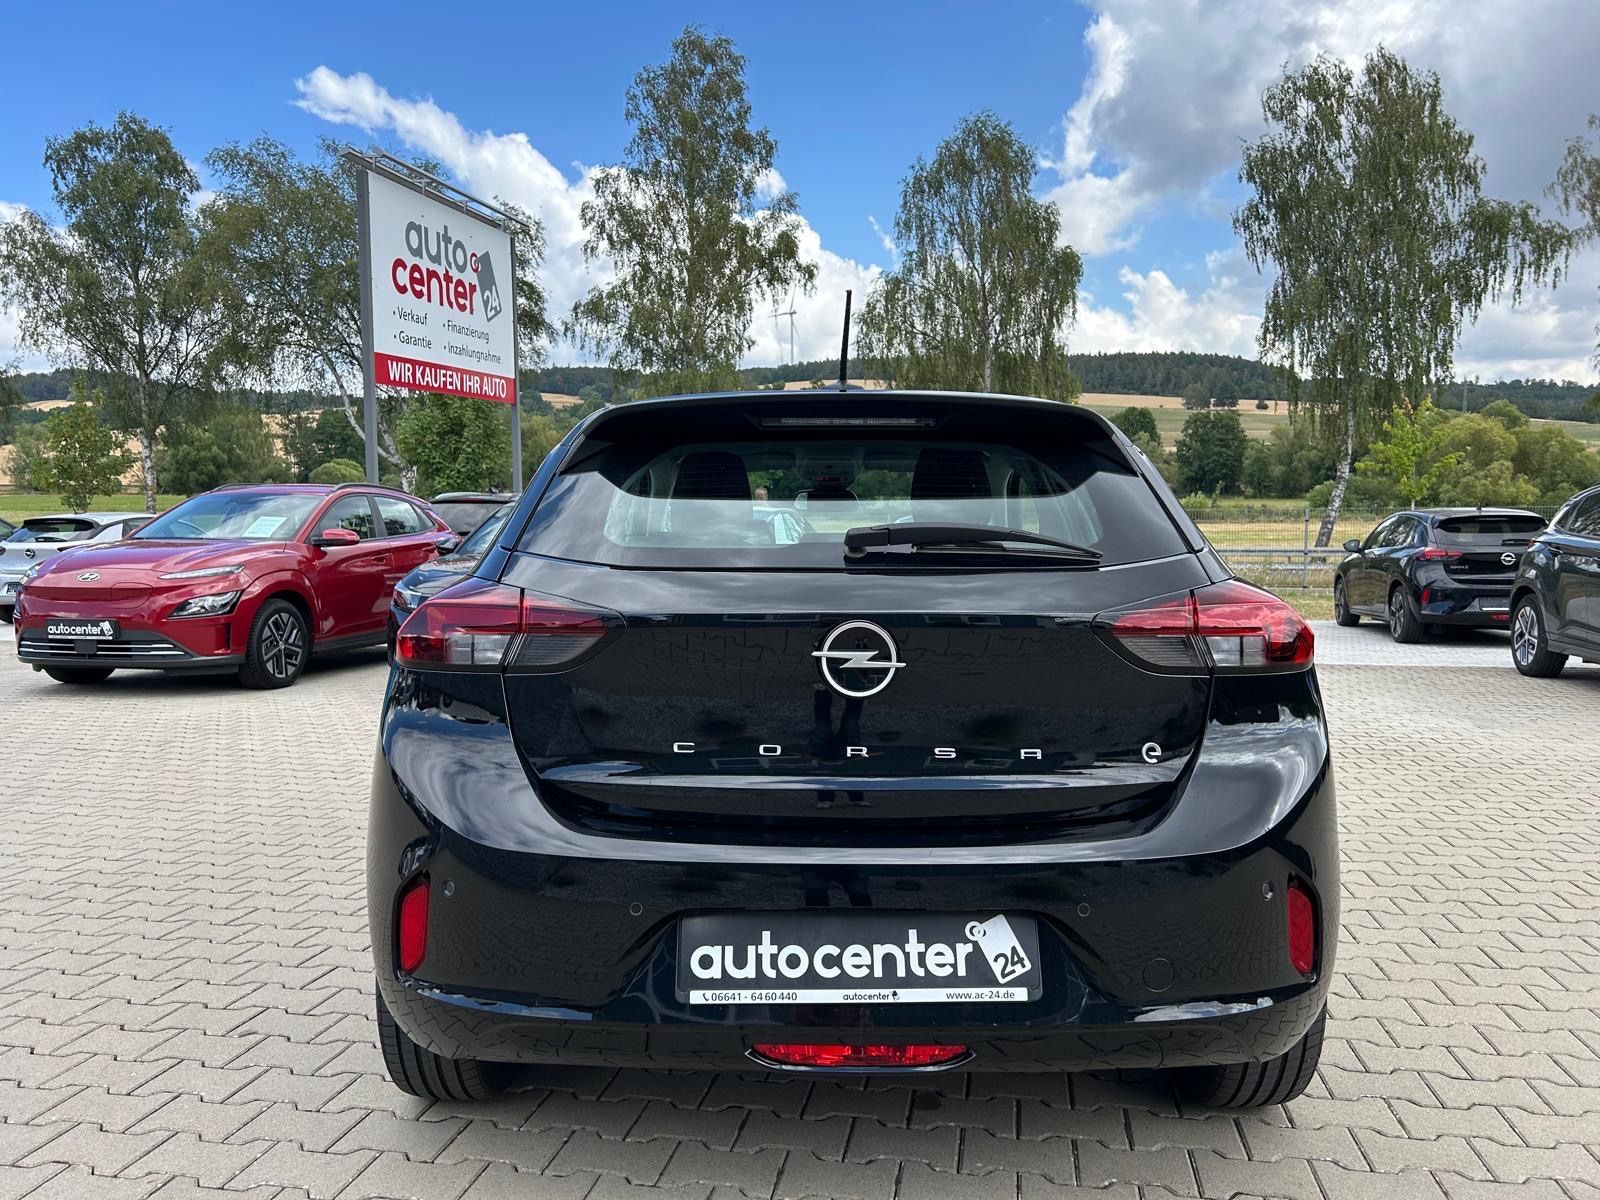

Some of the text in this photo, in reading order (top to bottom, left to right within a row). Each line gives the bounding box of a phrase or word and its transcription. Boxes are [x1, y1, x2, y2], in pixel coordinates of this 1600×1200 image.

[405, 221, 468, 274] auto
[392, 258, 477, 315] center
[484, 285, 500, 316] 24
[397, 306, 428, 326] Verkauf
[398, 330, 432, 350] Garantie
[447, 320, 490, 344] Finanzierung
[448, 341, 502, 364] Inzahlungnahme
[387, 359, 507, 399] WIR KAUFEN IHR AUTO
[47, 622, 102, 635] autocenter
[673, 742, 1042, 759] CORSA
[690, 929, 1025, 979] autocenter 24
[711, 992, 741, 1002] 06641
[843, 992, 890, 1001] autocenter
[946, 990, 1015, 1000] www.ac-24.de
